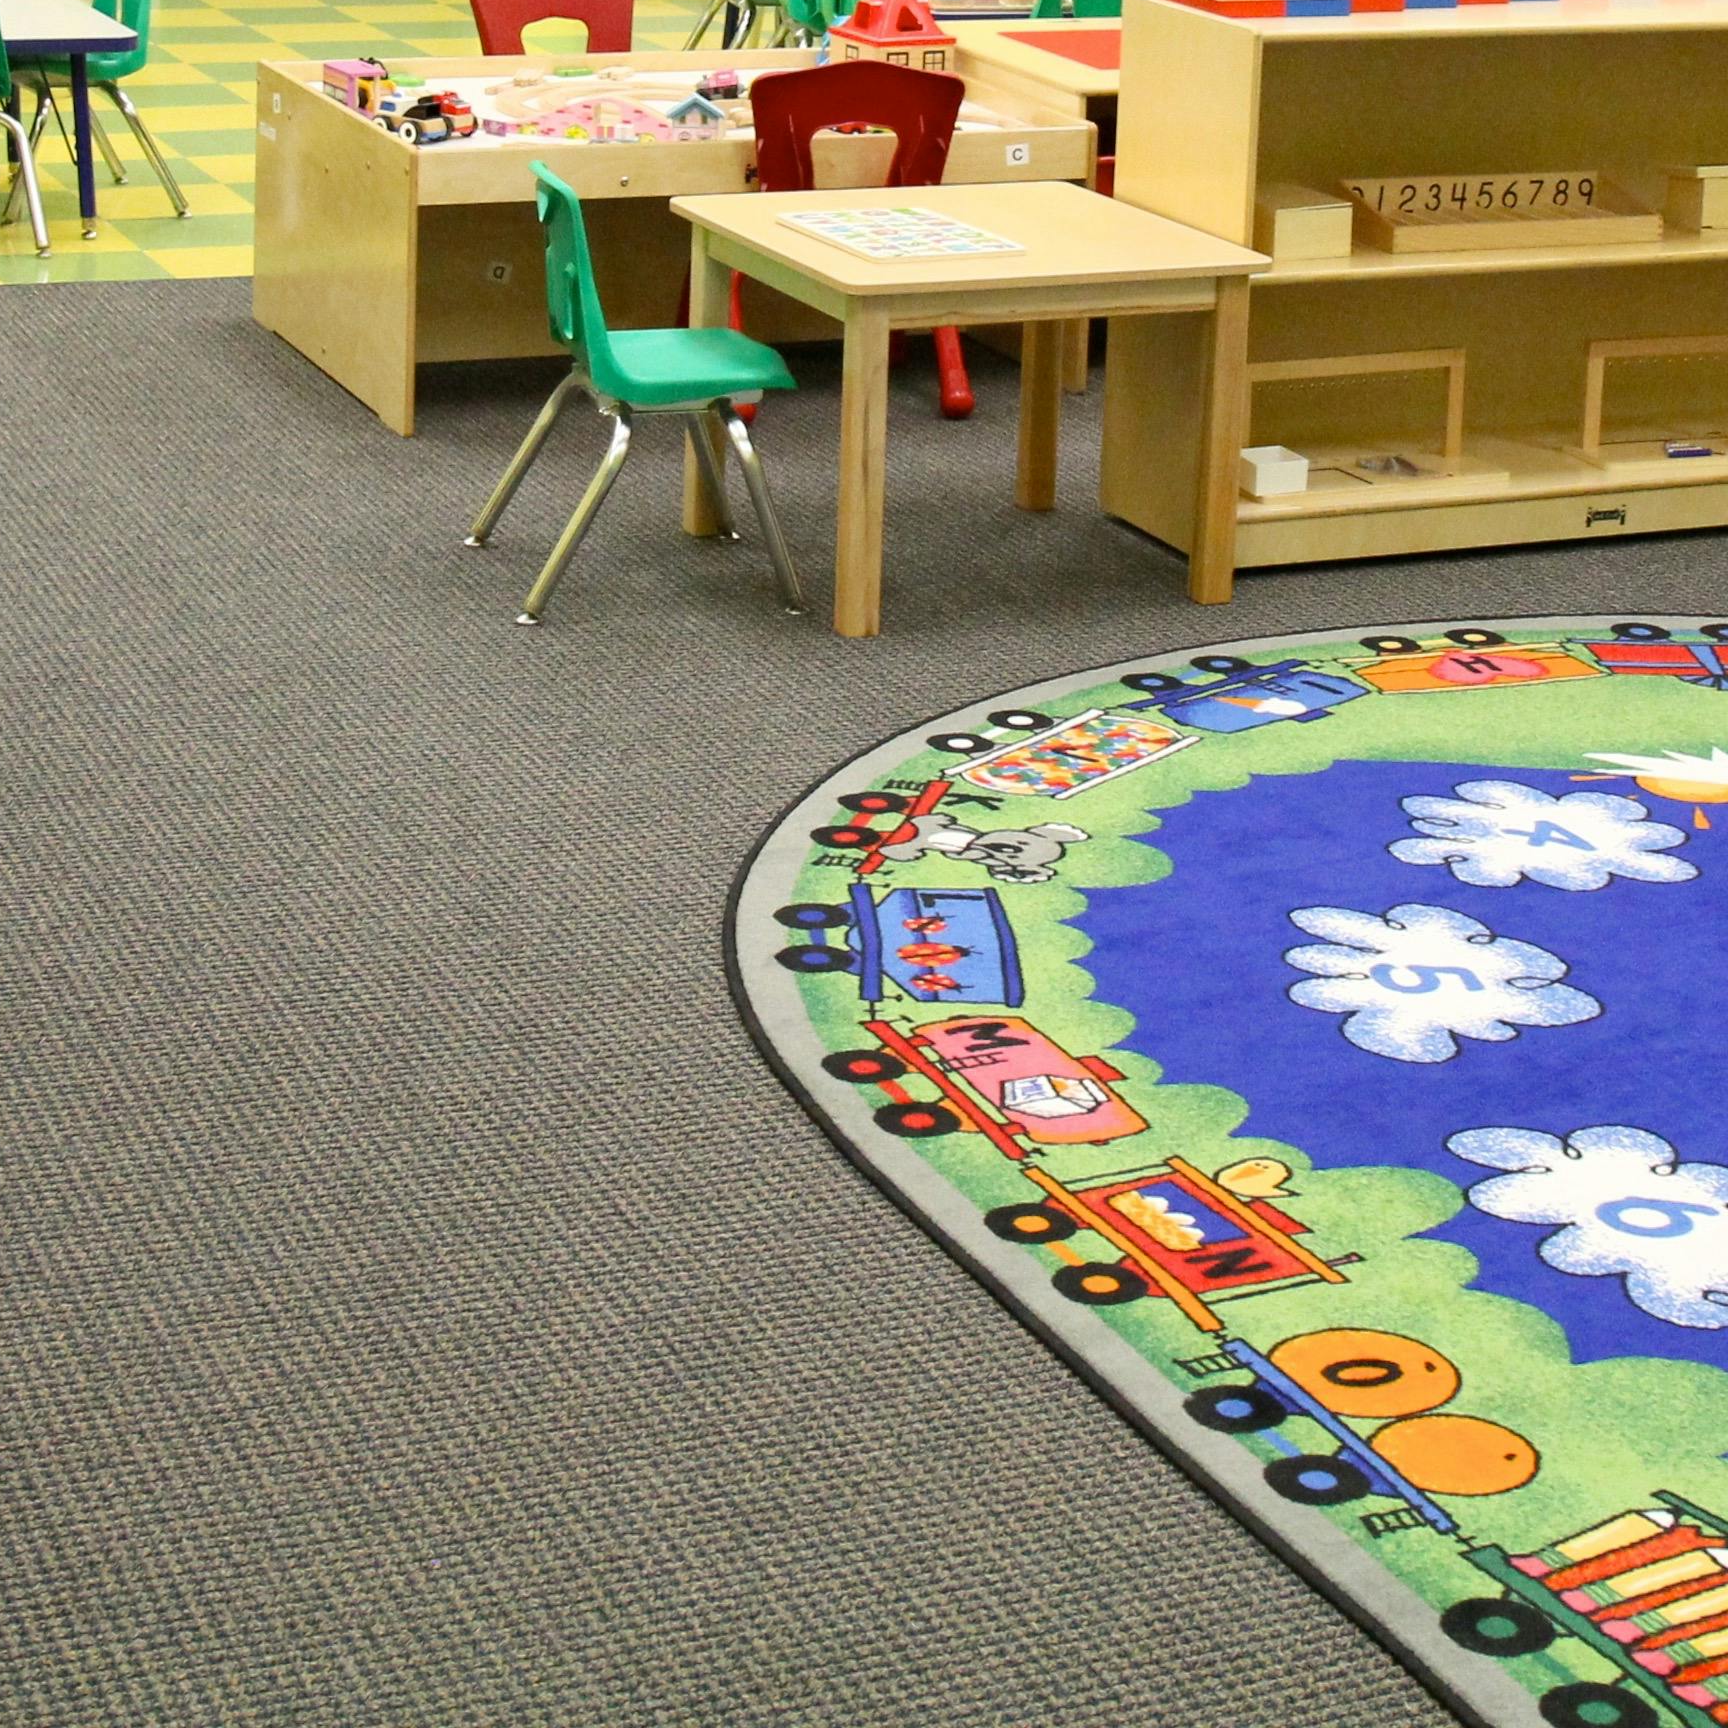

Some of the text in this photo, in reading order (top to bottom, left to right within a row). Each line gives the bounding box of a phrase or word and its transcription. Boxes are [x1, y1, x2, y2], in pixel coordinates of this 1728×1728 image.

[1377, 185, 1385, 211] 1
[1398, 184, 1417, 214] 2
[1424, 183, 1441, 212] 3
[1450, 182, 1467, 211] 4
[1475, 181, 1494, 210] 5
[1501, 180, 1518, 209] 6
[1529, 179, 1544, 206] 7
[1552, 178, 1569, 206] 8
[1578, 177, 1594, 206] 9
[1449, 656, 1503, 674] H
[940, 793, 1005, 812] K
[1499, 820, 1598, 852] 4
[919, 892, 985, 908] L
[1369, 962, 1485, 994] 5
[944, 1022, 1031, 1052] M
[1595, 1195, 1720, 1239] 6
[1186, 1246, 1272, 1280] N
[1320, 1358, 1404, 1388] O
